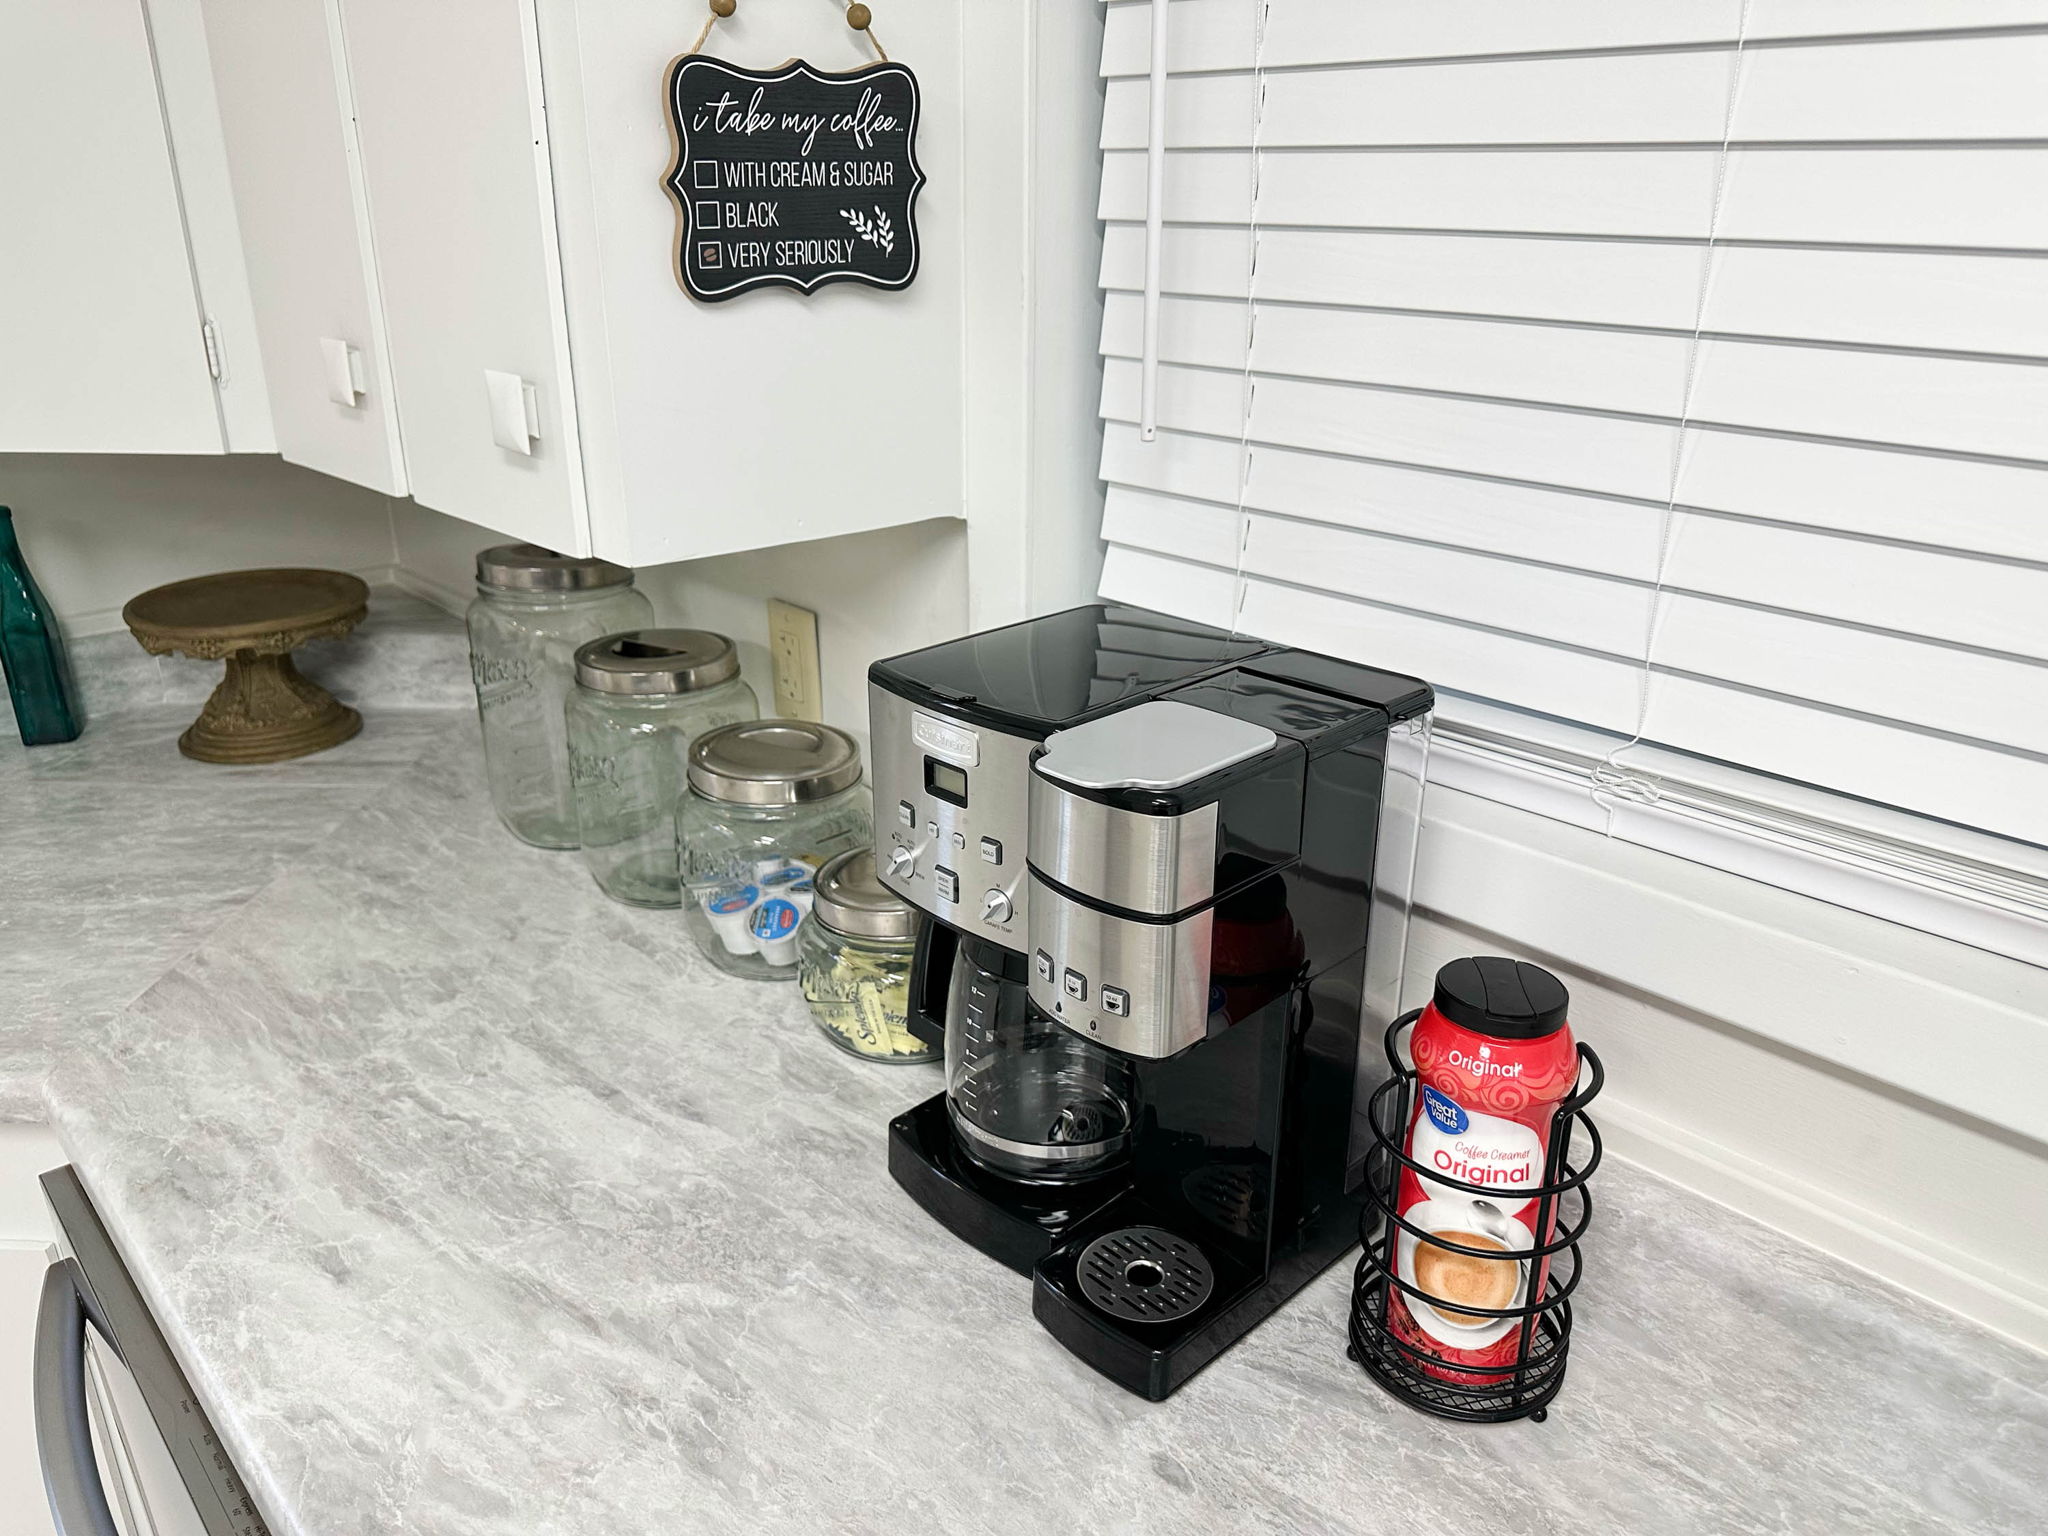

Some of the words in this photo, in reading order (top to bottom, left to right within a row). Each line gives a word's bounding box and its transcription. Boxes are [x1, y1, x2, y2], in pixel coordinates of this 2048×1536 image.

[693, 106, 709, 133] i
[705, 86, 776, 137] take
[781, 112, 826, 157] my
[724, 161, 766, 188] WITH
[770, 161, 826, 188] CREAM
[830, 161, 840, 187] &
[844, 161, 894, 187] SUGAR
[725, 202, 780, 228] BLACK
[728, 242, 771, 269] VERY
[775, 238, 855, 267] SERIOUSLY
[1085, 1030, 1102, 1041] CLEAN
[1448, 1050, 1522, 1077] Original
[1425, 1090, 1458, 1121] Great
[1431, 1107, 1458, 1129] Value
[1455, 1141, 1489, 1160] Coffee
[1490, 1148, 1531, 1160] Creamer
[1433, 1149, 1530, 1185] Original
